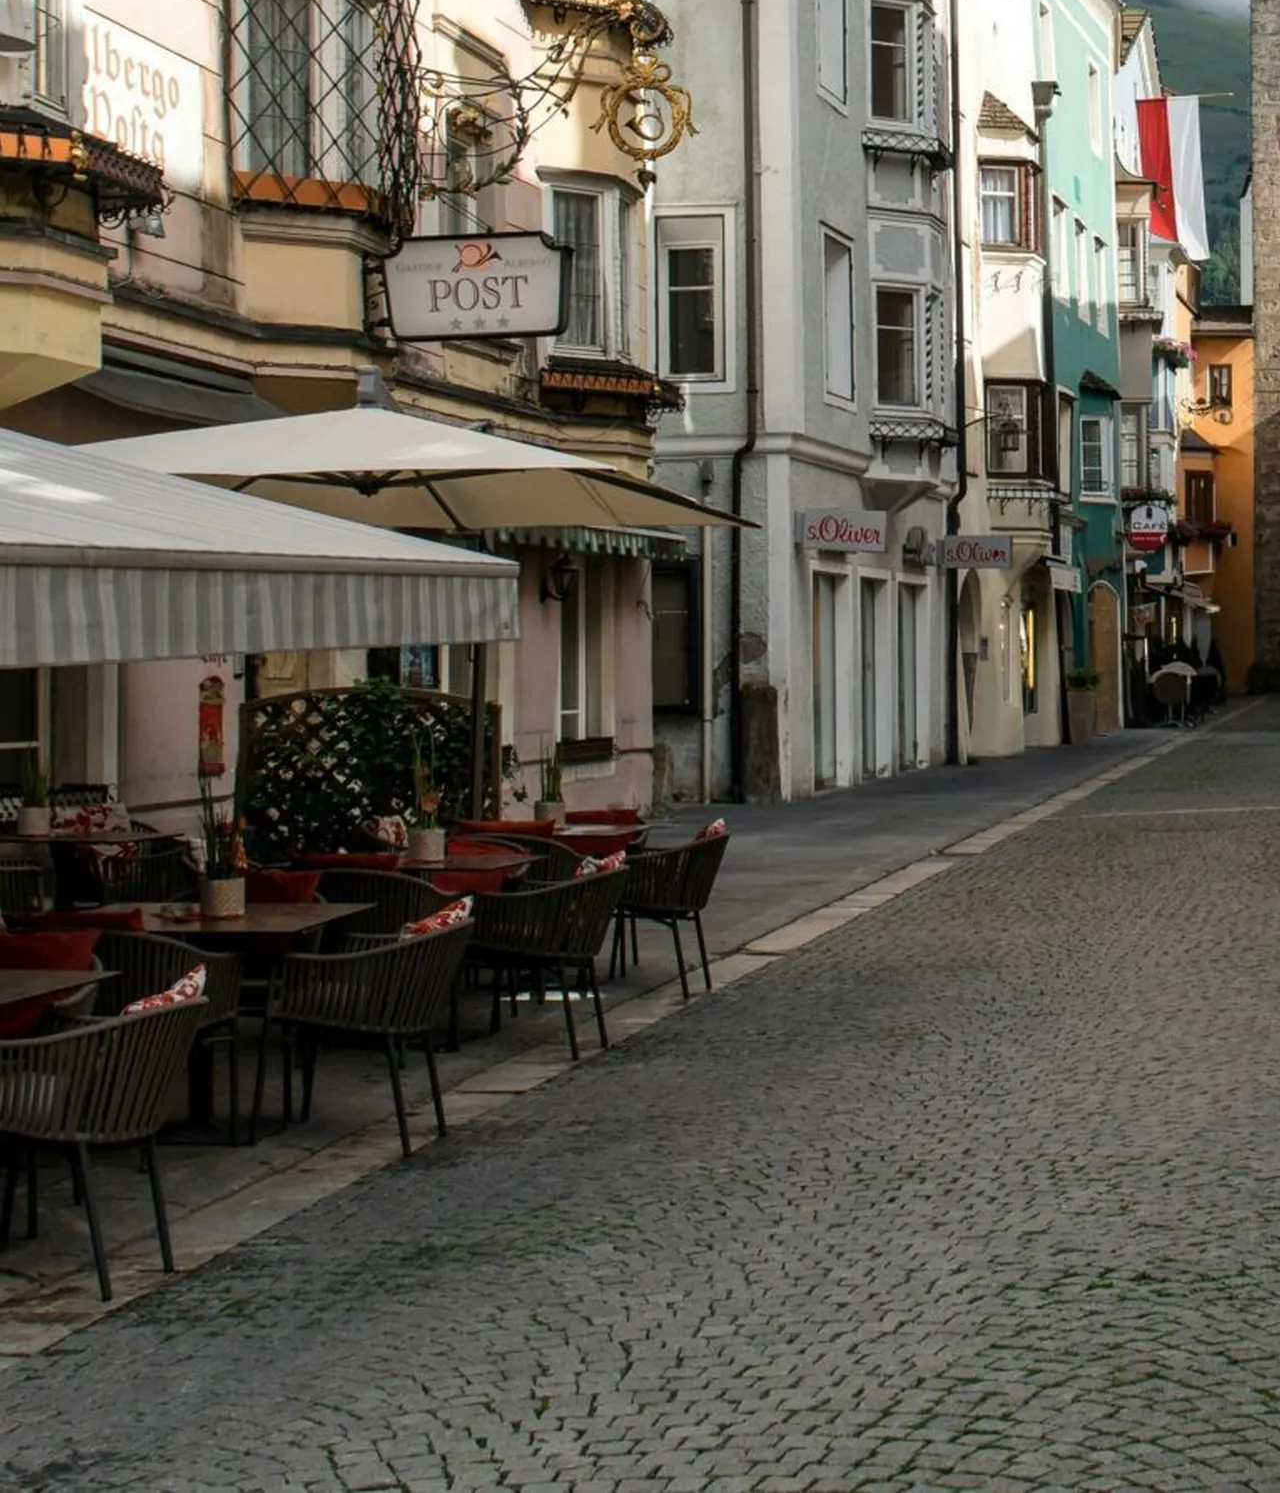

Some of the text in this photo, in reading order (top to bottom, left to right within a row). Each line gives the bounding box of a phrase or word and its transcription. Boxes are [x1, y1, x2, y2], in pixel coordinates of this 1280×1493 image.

[84, 23, 180, 119] lbergo
[429, 275, 528, 312] POST
[806, 515, 881, 545] s.Oliver
[946, 540, 1007, 564] s.Oliver
